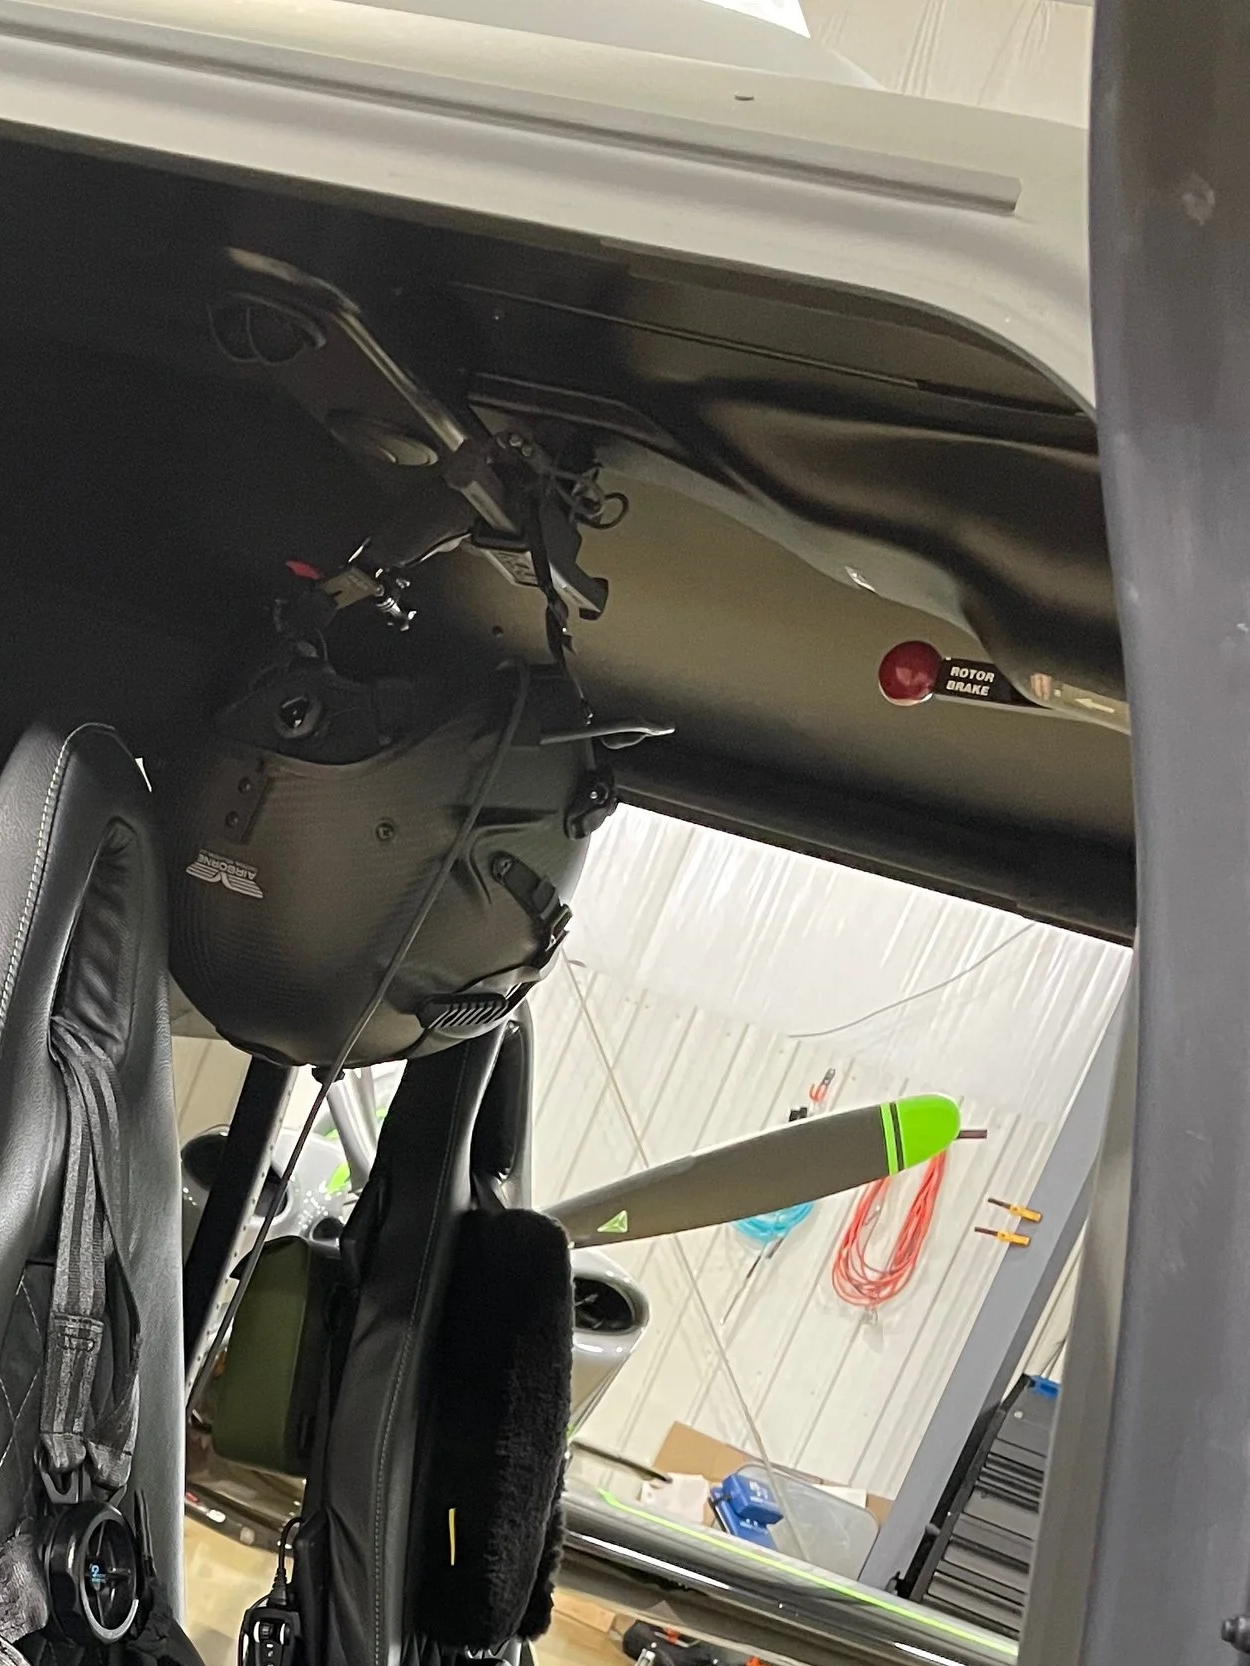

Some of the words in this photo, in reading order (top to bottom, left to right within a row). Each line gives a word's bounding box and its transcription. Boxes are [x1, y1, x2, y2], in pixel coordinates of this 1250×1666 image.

[950, 666, 995, 683] ROTOR
[946, 680, 990, 697] BRAKE
[197, 853, 257, 880] AIRBORNE
